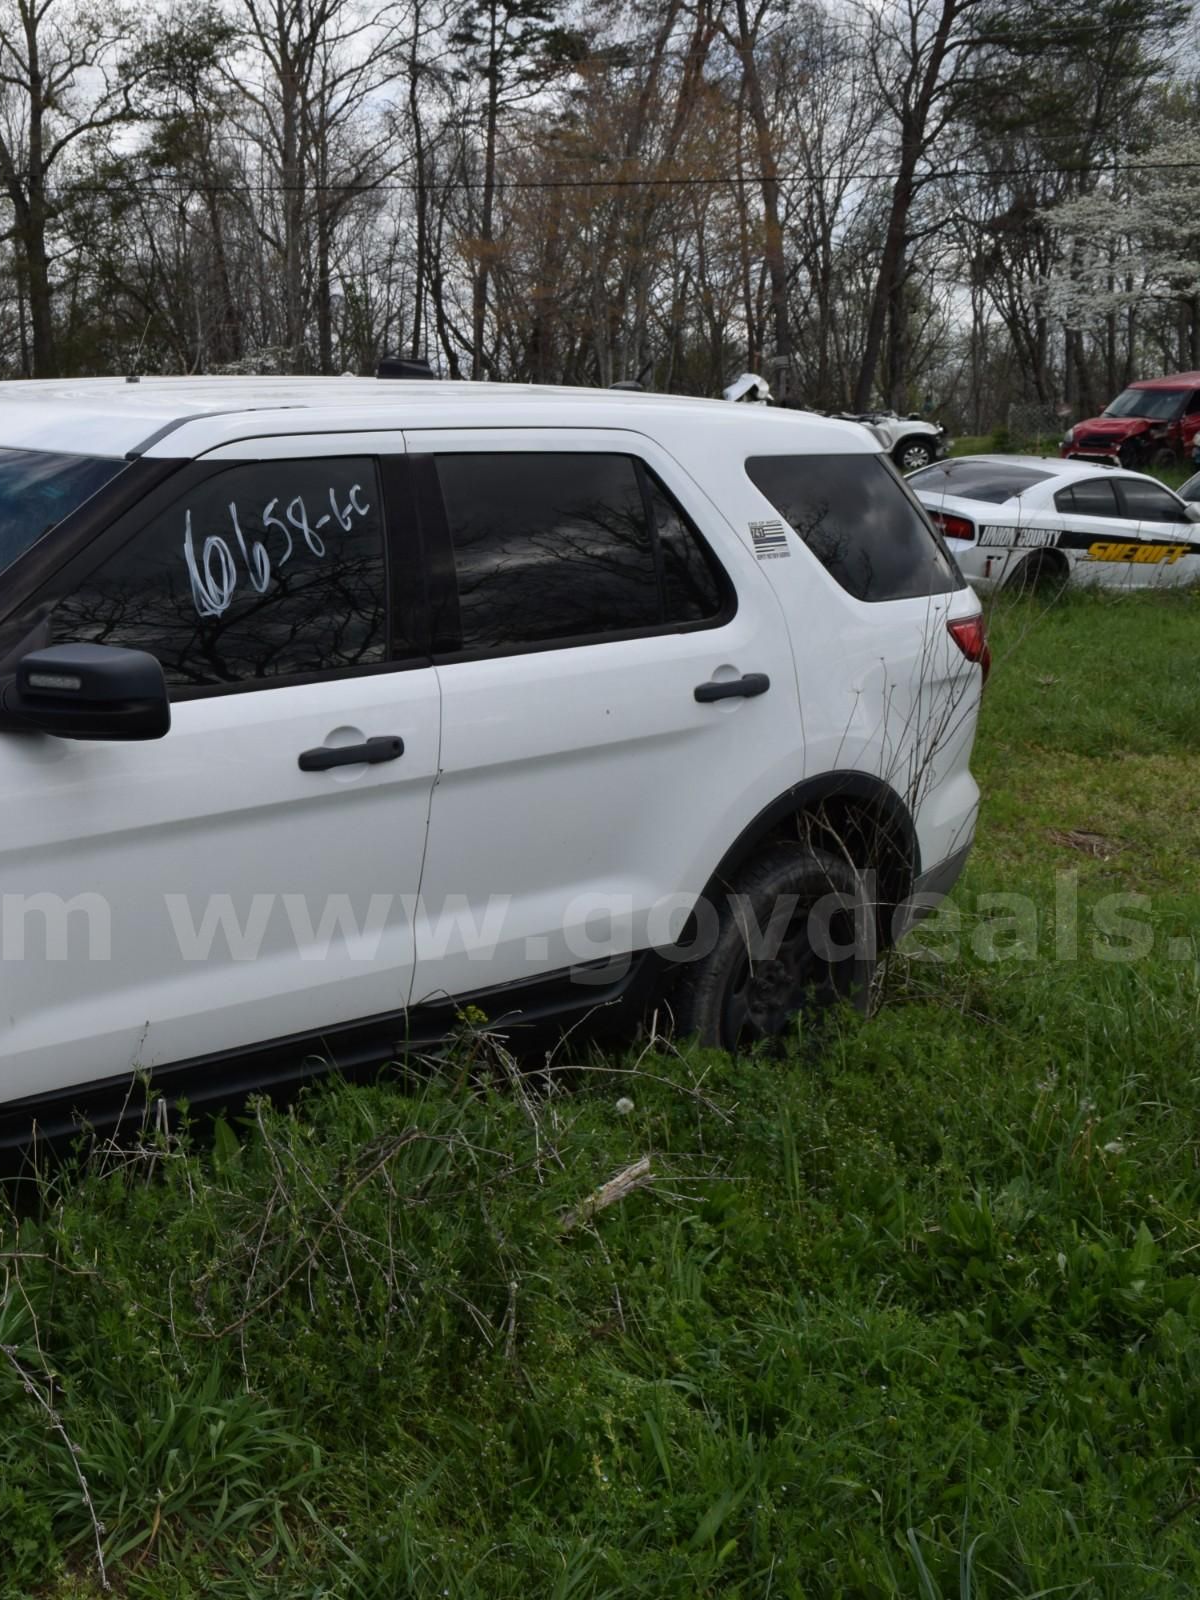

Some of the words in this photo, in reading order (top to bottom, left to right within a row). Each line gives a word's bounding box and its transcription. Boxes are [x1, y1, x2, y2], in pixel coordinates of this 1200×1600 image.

[980, 526, 1017, 547] UNION
[1017, 529, 1063, 548] COUNTY
[1084, 541, 1192, 565] SHERIFF
